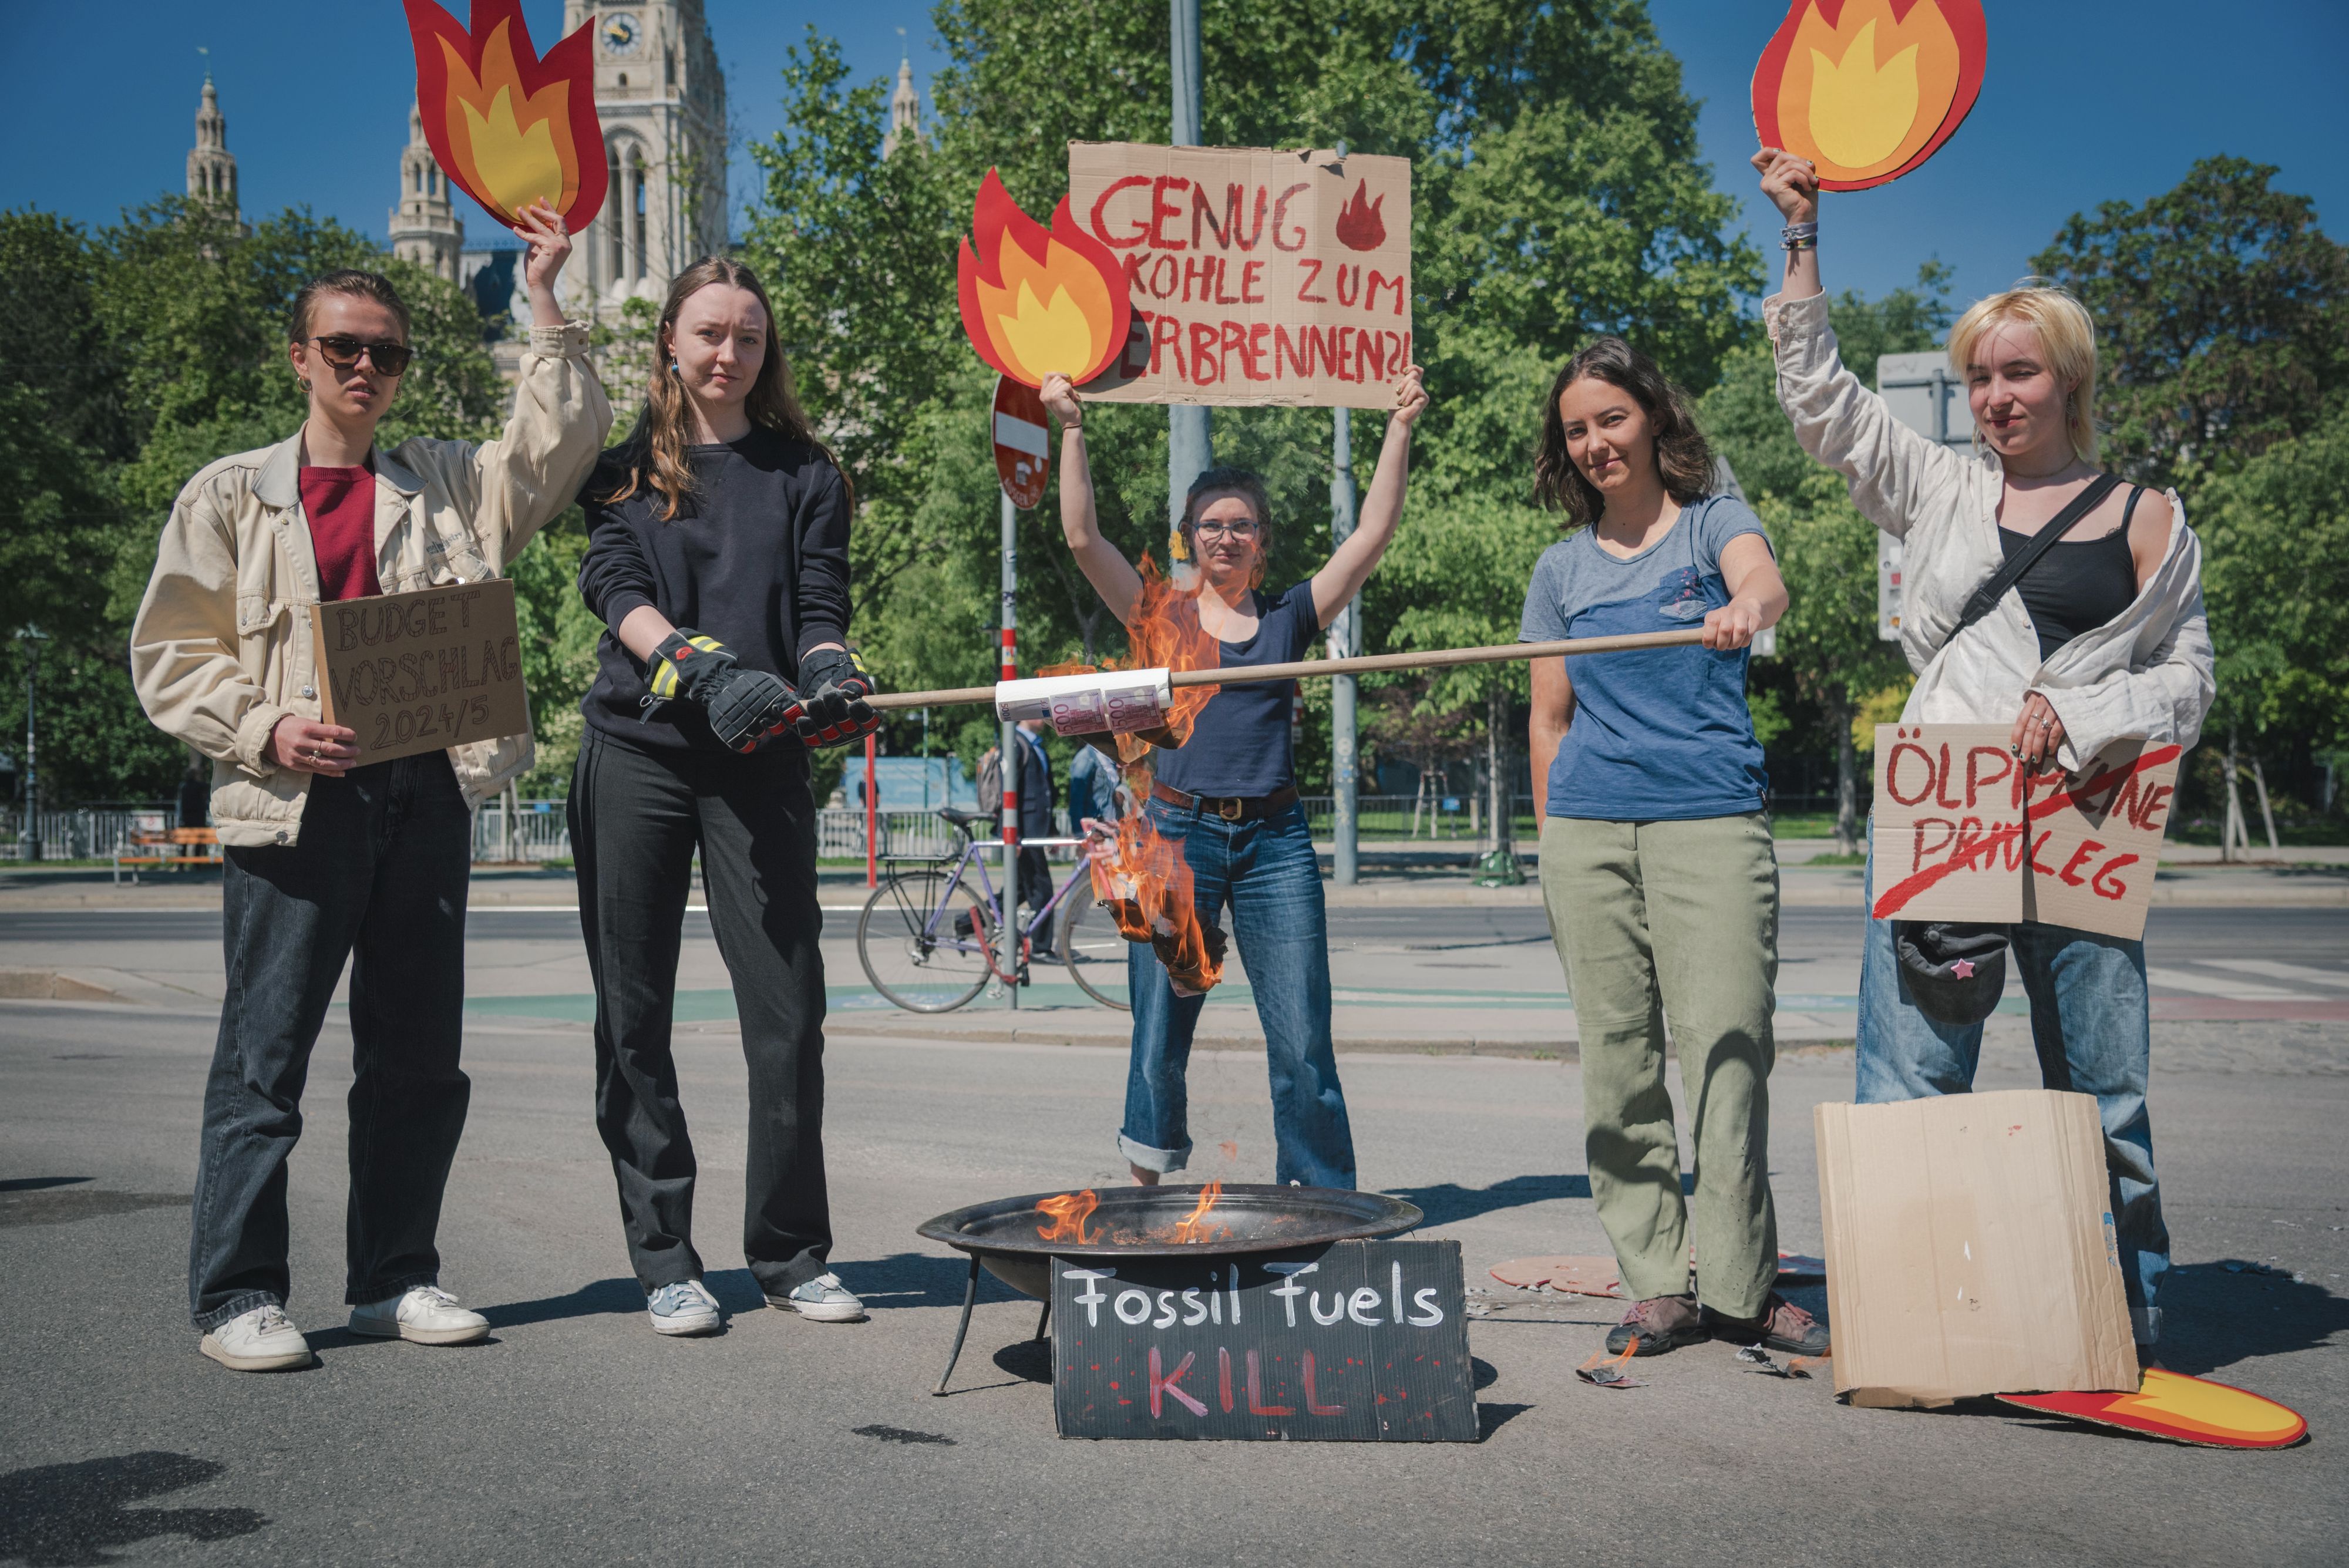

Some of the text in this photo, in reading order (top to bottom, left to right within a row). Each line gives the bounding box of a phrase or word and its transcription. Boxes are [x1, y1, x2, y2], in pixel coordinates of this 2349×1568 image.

[1090, 175, 1312, 252] GENUG
[1123, 253, 1404, 315] KOHLE ZUM
[1120, 310, 1411, 386] ERBRENNEN?!
[335, 590, 480, 651] BUDGET
[330, 636, 518, 712] VORSCHLAG
[371, 695, 489, 751] 2024/5
[1054, 704, 1073, 733] 500
[1062, 1260, 1443, 1329] Fossil Fuels
[1149, 1346, 1347, 1419] KILL
